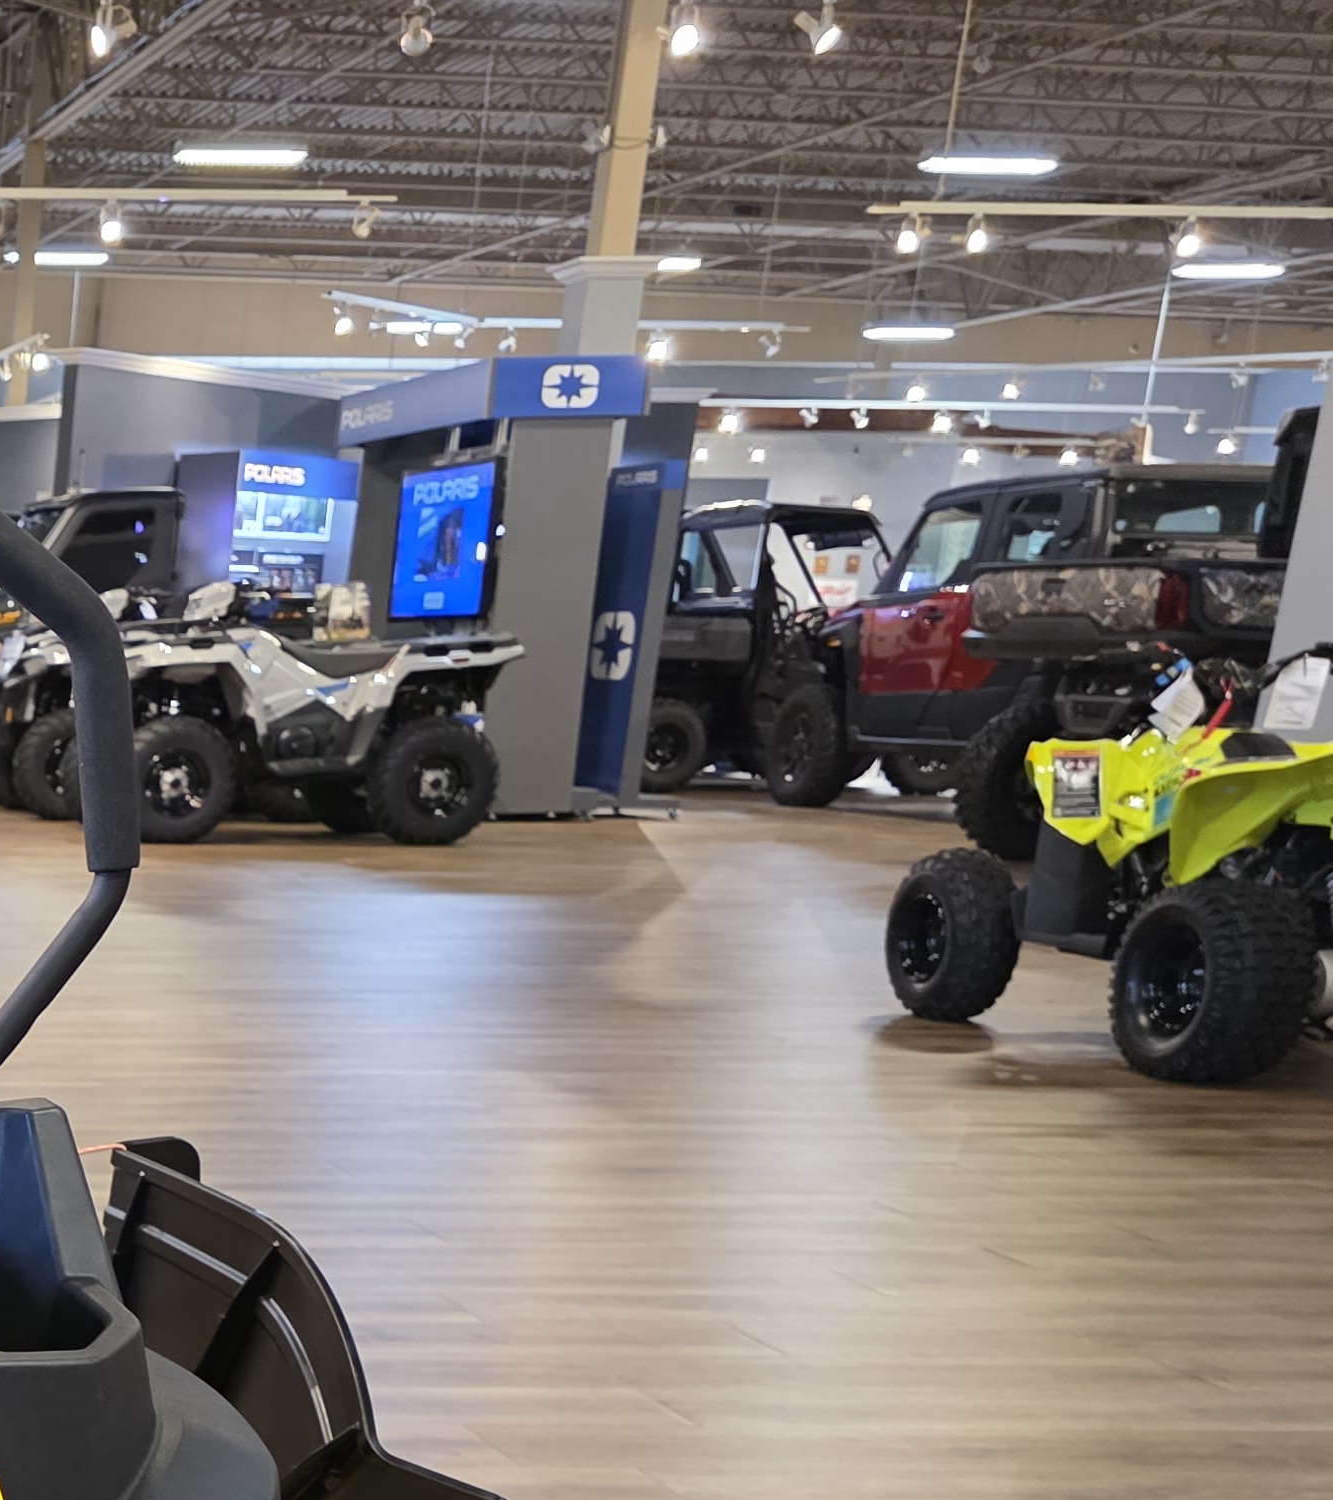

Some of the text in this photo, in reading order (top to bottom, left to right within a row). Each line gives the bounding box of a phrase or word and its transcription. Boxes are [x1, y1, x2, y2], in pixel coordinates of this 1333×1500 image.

[341, 400, 394, 431] POLARIS
[244, 463, 306, 487] POLARIS
[413, 474, 480, 507] POLARIS
